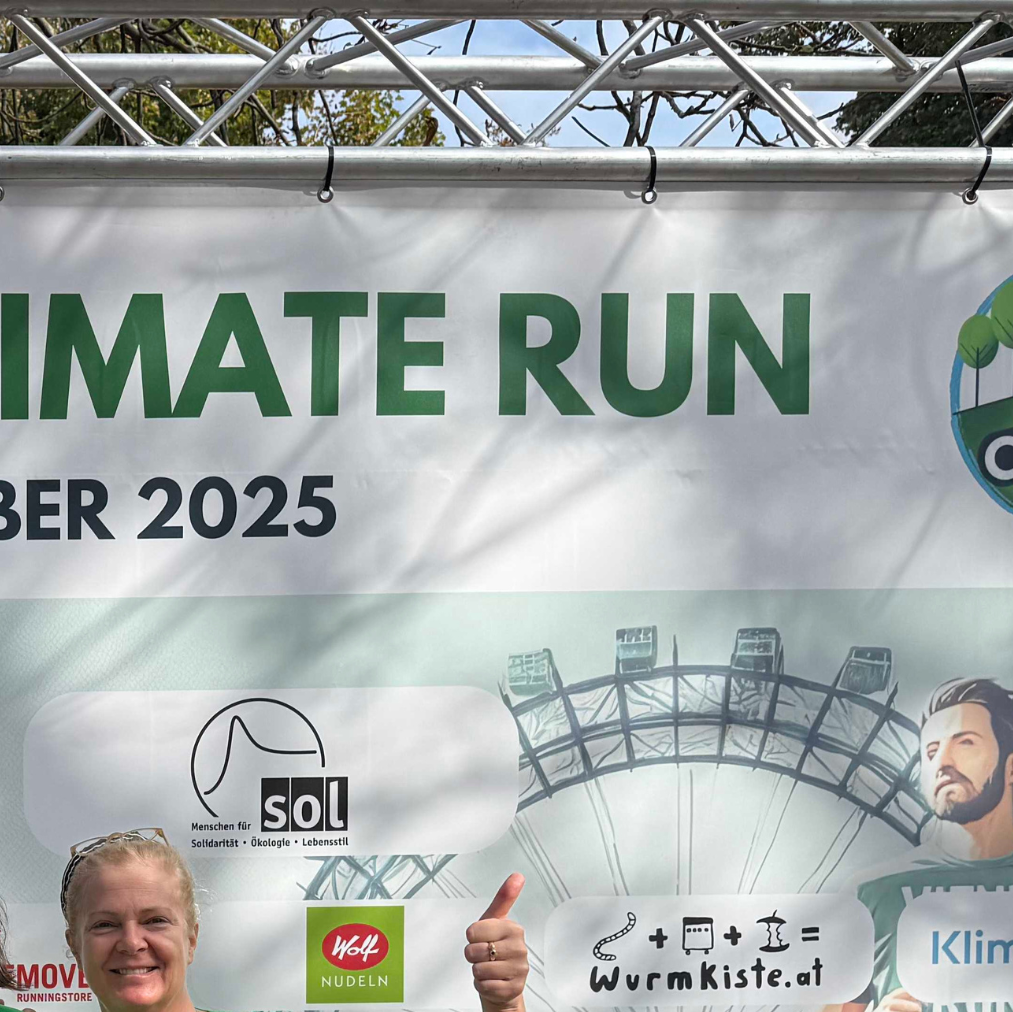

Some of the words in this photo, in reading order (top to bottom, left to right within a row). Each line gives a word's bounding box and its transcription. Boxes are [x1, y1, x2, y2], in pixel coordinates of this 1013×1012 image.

[498, 292, 811, 418] RUN
[137, 474, 337, 539] 2025
[191, 822, 235, 831] Menschen
[238, 821, 251, 831] für
[191, 838, 239, 848] Solidarität
[250, 836, 291, 848] Ökologie
[302, 837, 349, 847] Lebensstil
[331, 934, 380, 963] Wolf
[321, 975, 388, 988] NUDELN
[17, 992, 93, 1003] RUNNINGSTORE
